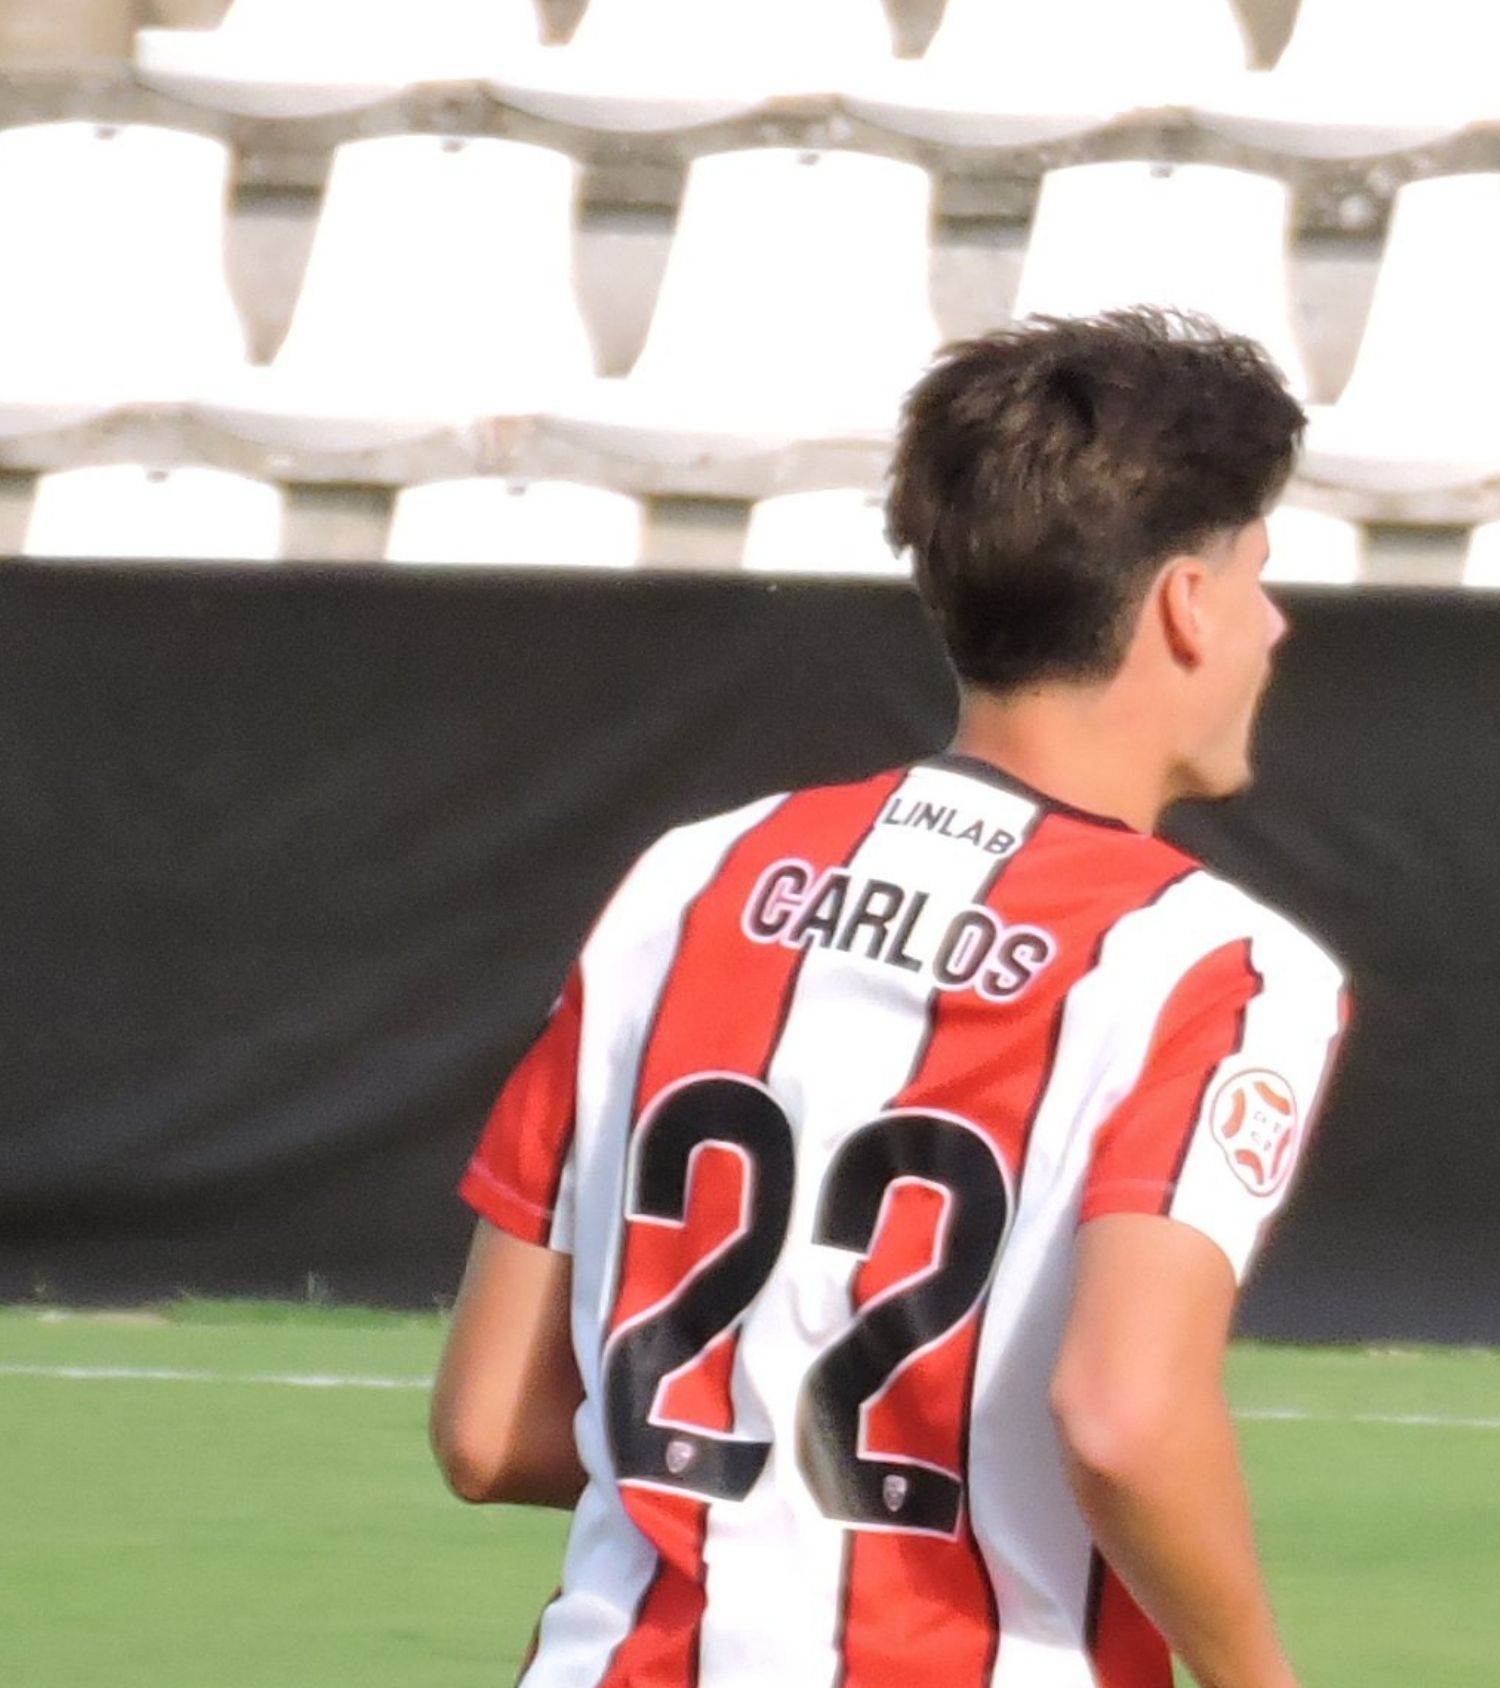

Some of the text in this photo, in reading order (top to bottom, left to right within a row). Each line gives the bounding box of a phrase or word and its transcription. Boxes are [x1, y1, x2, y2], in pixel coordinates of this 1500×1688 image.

[884, 797, 1016, 856] LINLAB
[745, 860, 1050, 998] CARLOS
[602, 1070, 1012, 1540] 22
